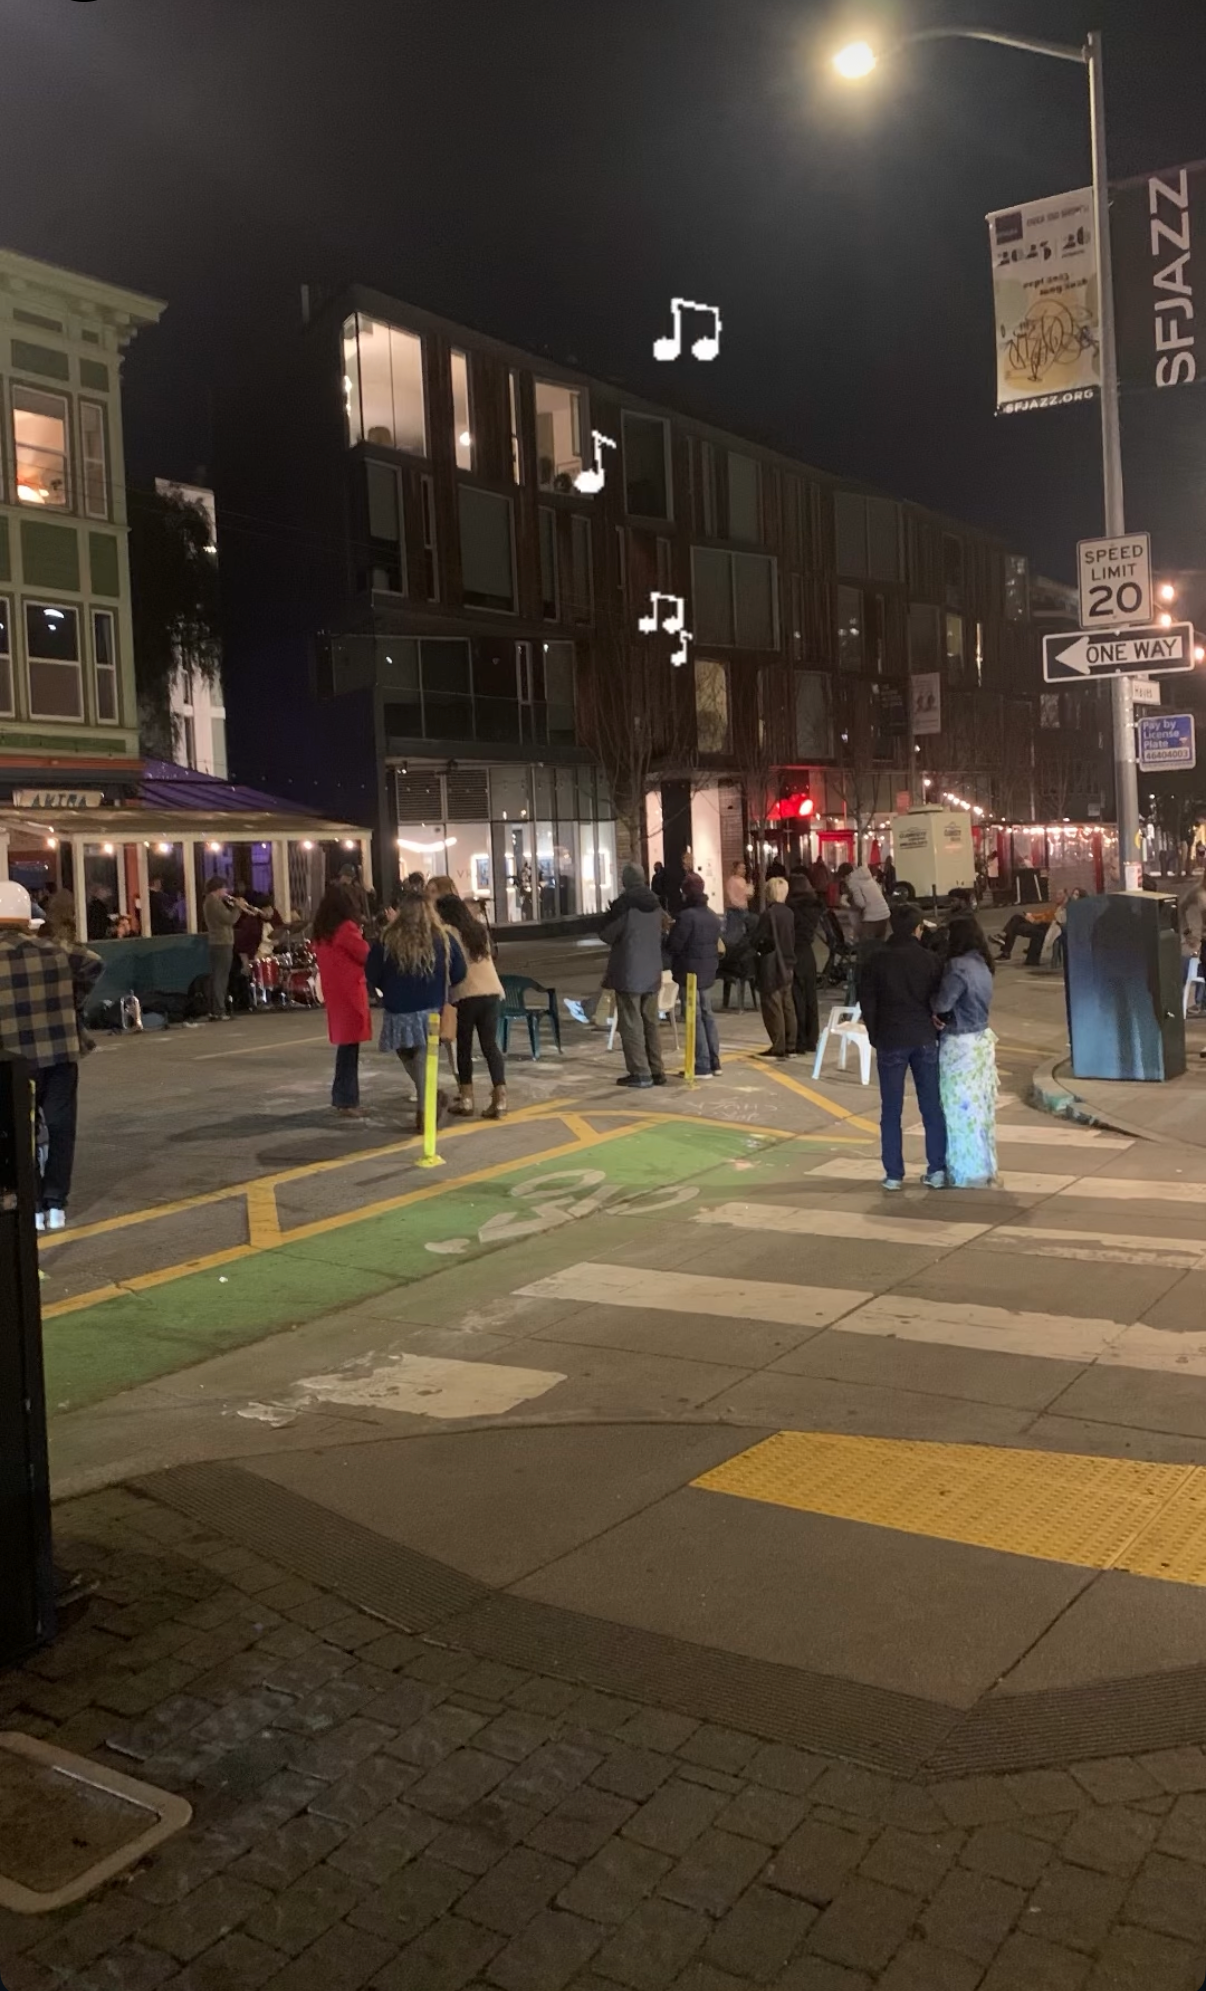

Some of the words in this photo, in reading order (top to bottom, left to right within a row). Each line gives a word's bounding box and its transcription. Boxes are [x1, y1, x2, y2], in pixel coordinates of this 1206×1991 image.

[1148, 169, 1196, 387] SFJAZZ
[1004, 389, 1093, 414] SFJAZZ.ORG
[1085, 545, 1143, 564] SPEED
[1091, 563, 1137, 581] LIMIT
[1089, 582, 1142, 617] 20
[1086, 643, 1128, 663] ONE
[1134, 638, 1177, 659] WAY
[1143, 721, 1160, 731] Pay
[1163, 719, 1176, 730] by
[1143, 730, 1180, 739] License
[1143, 740, 1168, 749] Plate
